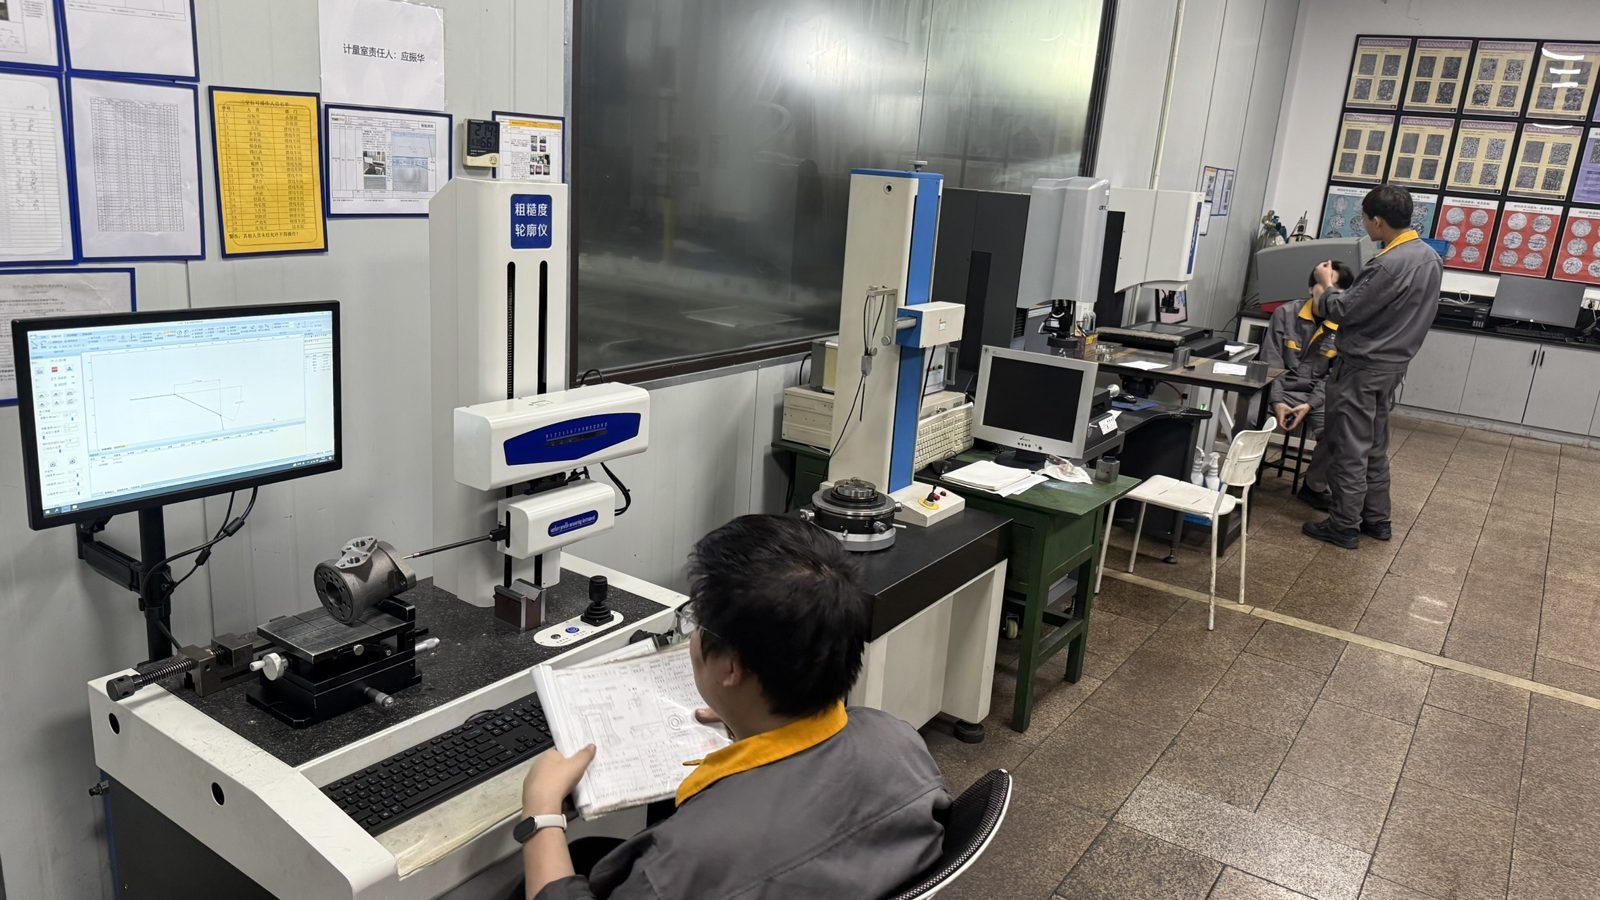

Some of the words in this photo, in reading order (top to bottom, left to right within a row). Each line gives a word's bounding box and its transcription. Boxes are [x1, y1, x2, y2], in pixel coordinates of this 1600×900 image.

[343, 43, 425, 63] 计量室责任人：应振华
[515, 202, 548, 216] 粗糙度
[515, 224, 548, 237] 轮廓仪
